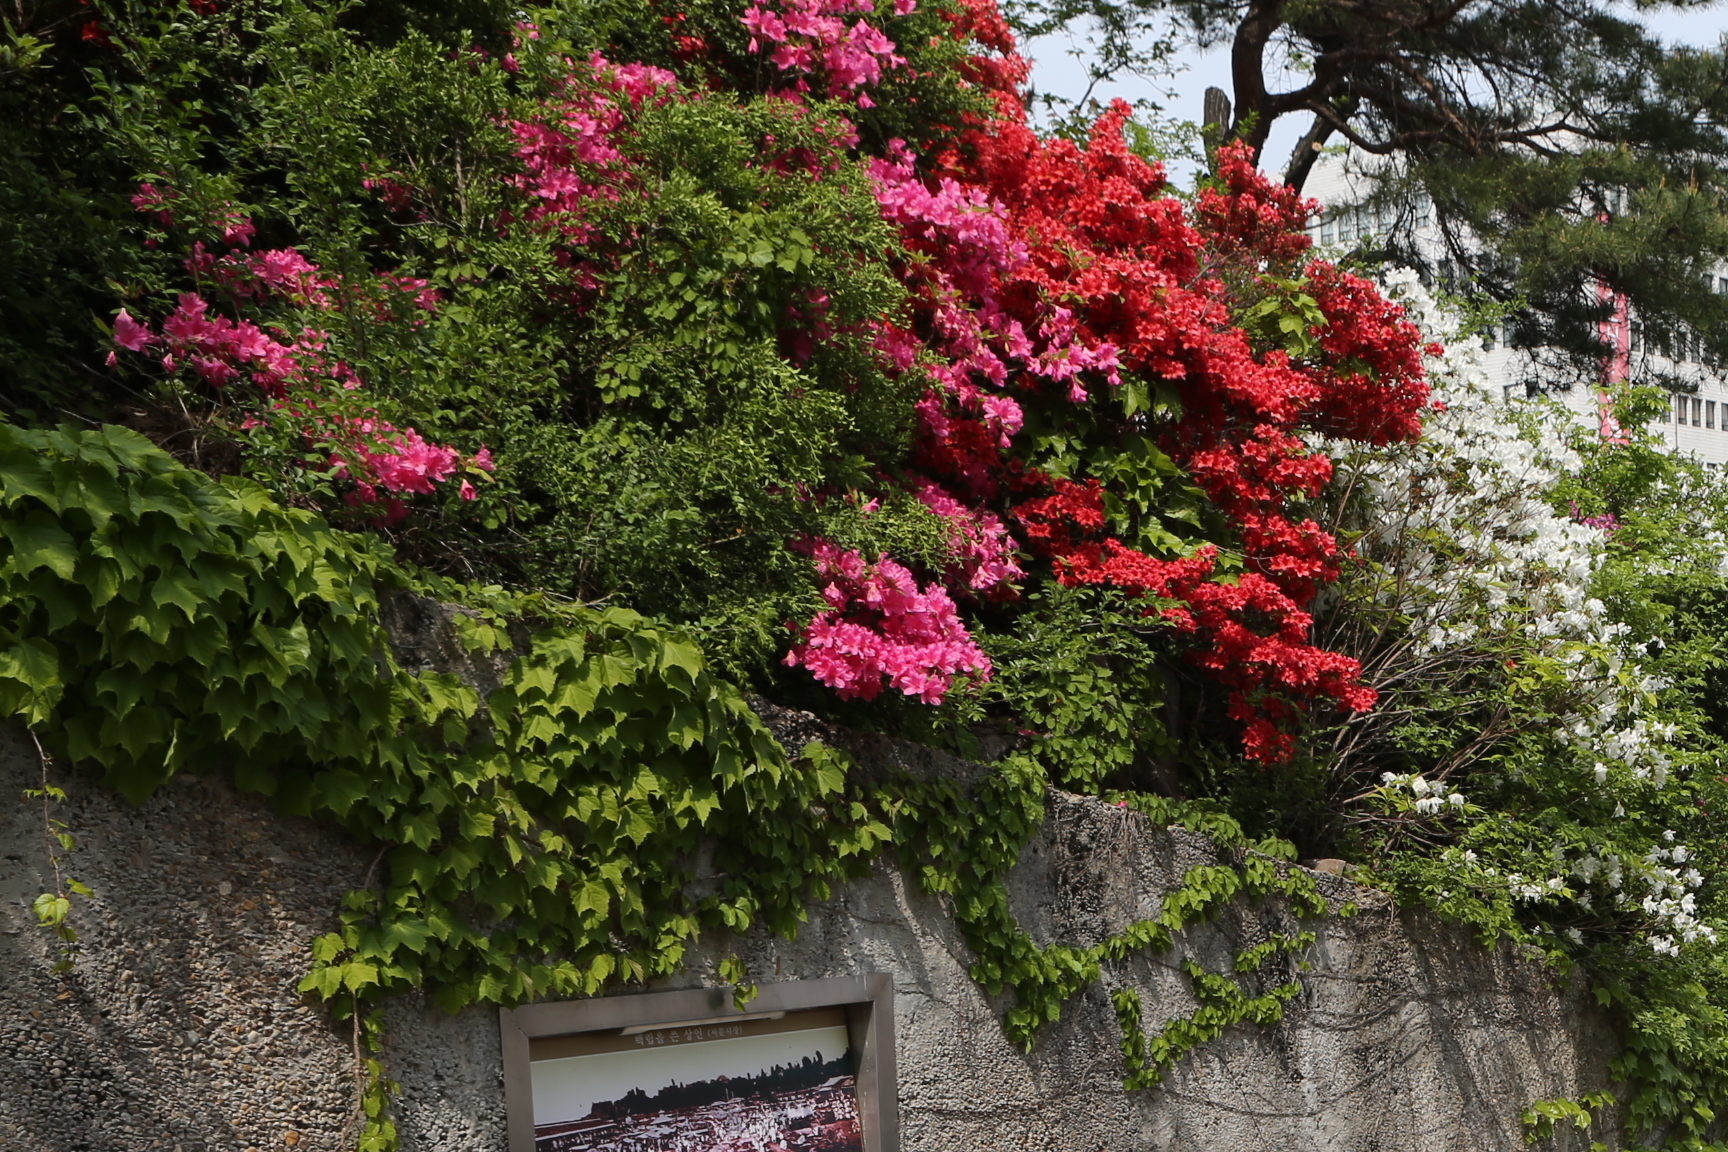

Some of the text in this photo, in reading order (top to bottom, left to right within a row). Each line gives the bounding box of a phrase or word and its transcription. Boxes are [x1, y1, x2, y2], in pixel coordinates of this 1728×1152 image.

[634, 1032, 665, 1046] 백립을
[669, 1030, 680, 1043] 쓴
[684, 1027, 703, 1042] 상인
